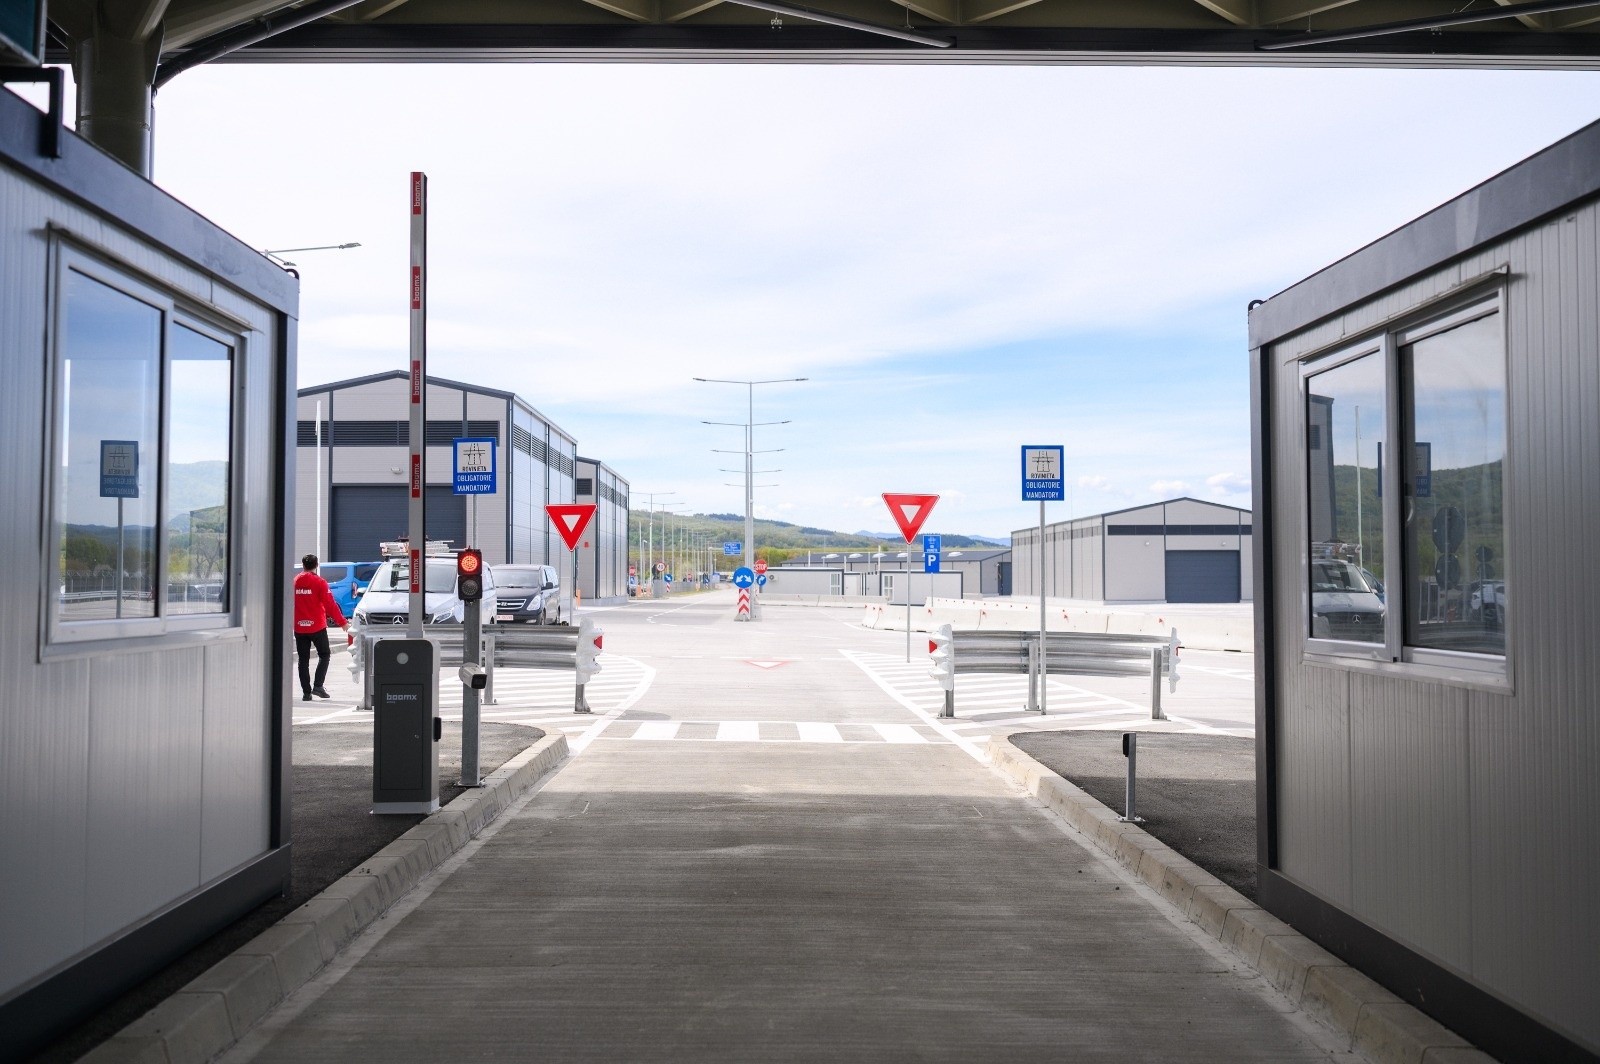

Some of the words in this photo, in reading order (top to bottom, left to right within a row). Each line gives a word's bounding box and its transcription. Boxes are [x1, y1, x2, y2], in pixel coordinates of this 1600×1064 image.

[457, 474, 492, 482] OBLIGATORIE
[457, 484, 491, 492] MANDATORY
[1026, 481, 1061, 489] OBLIGATORIE
[1026, 491, 1059, 499] MANDATORY
[928, 554, 937, 567] P
[755, 563, 767, 571] STOP
[386, 692, 418, 701] boomx
